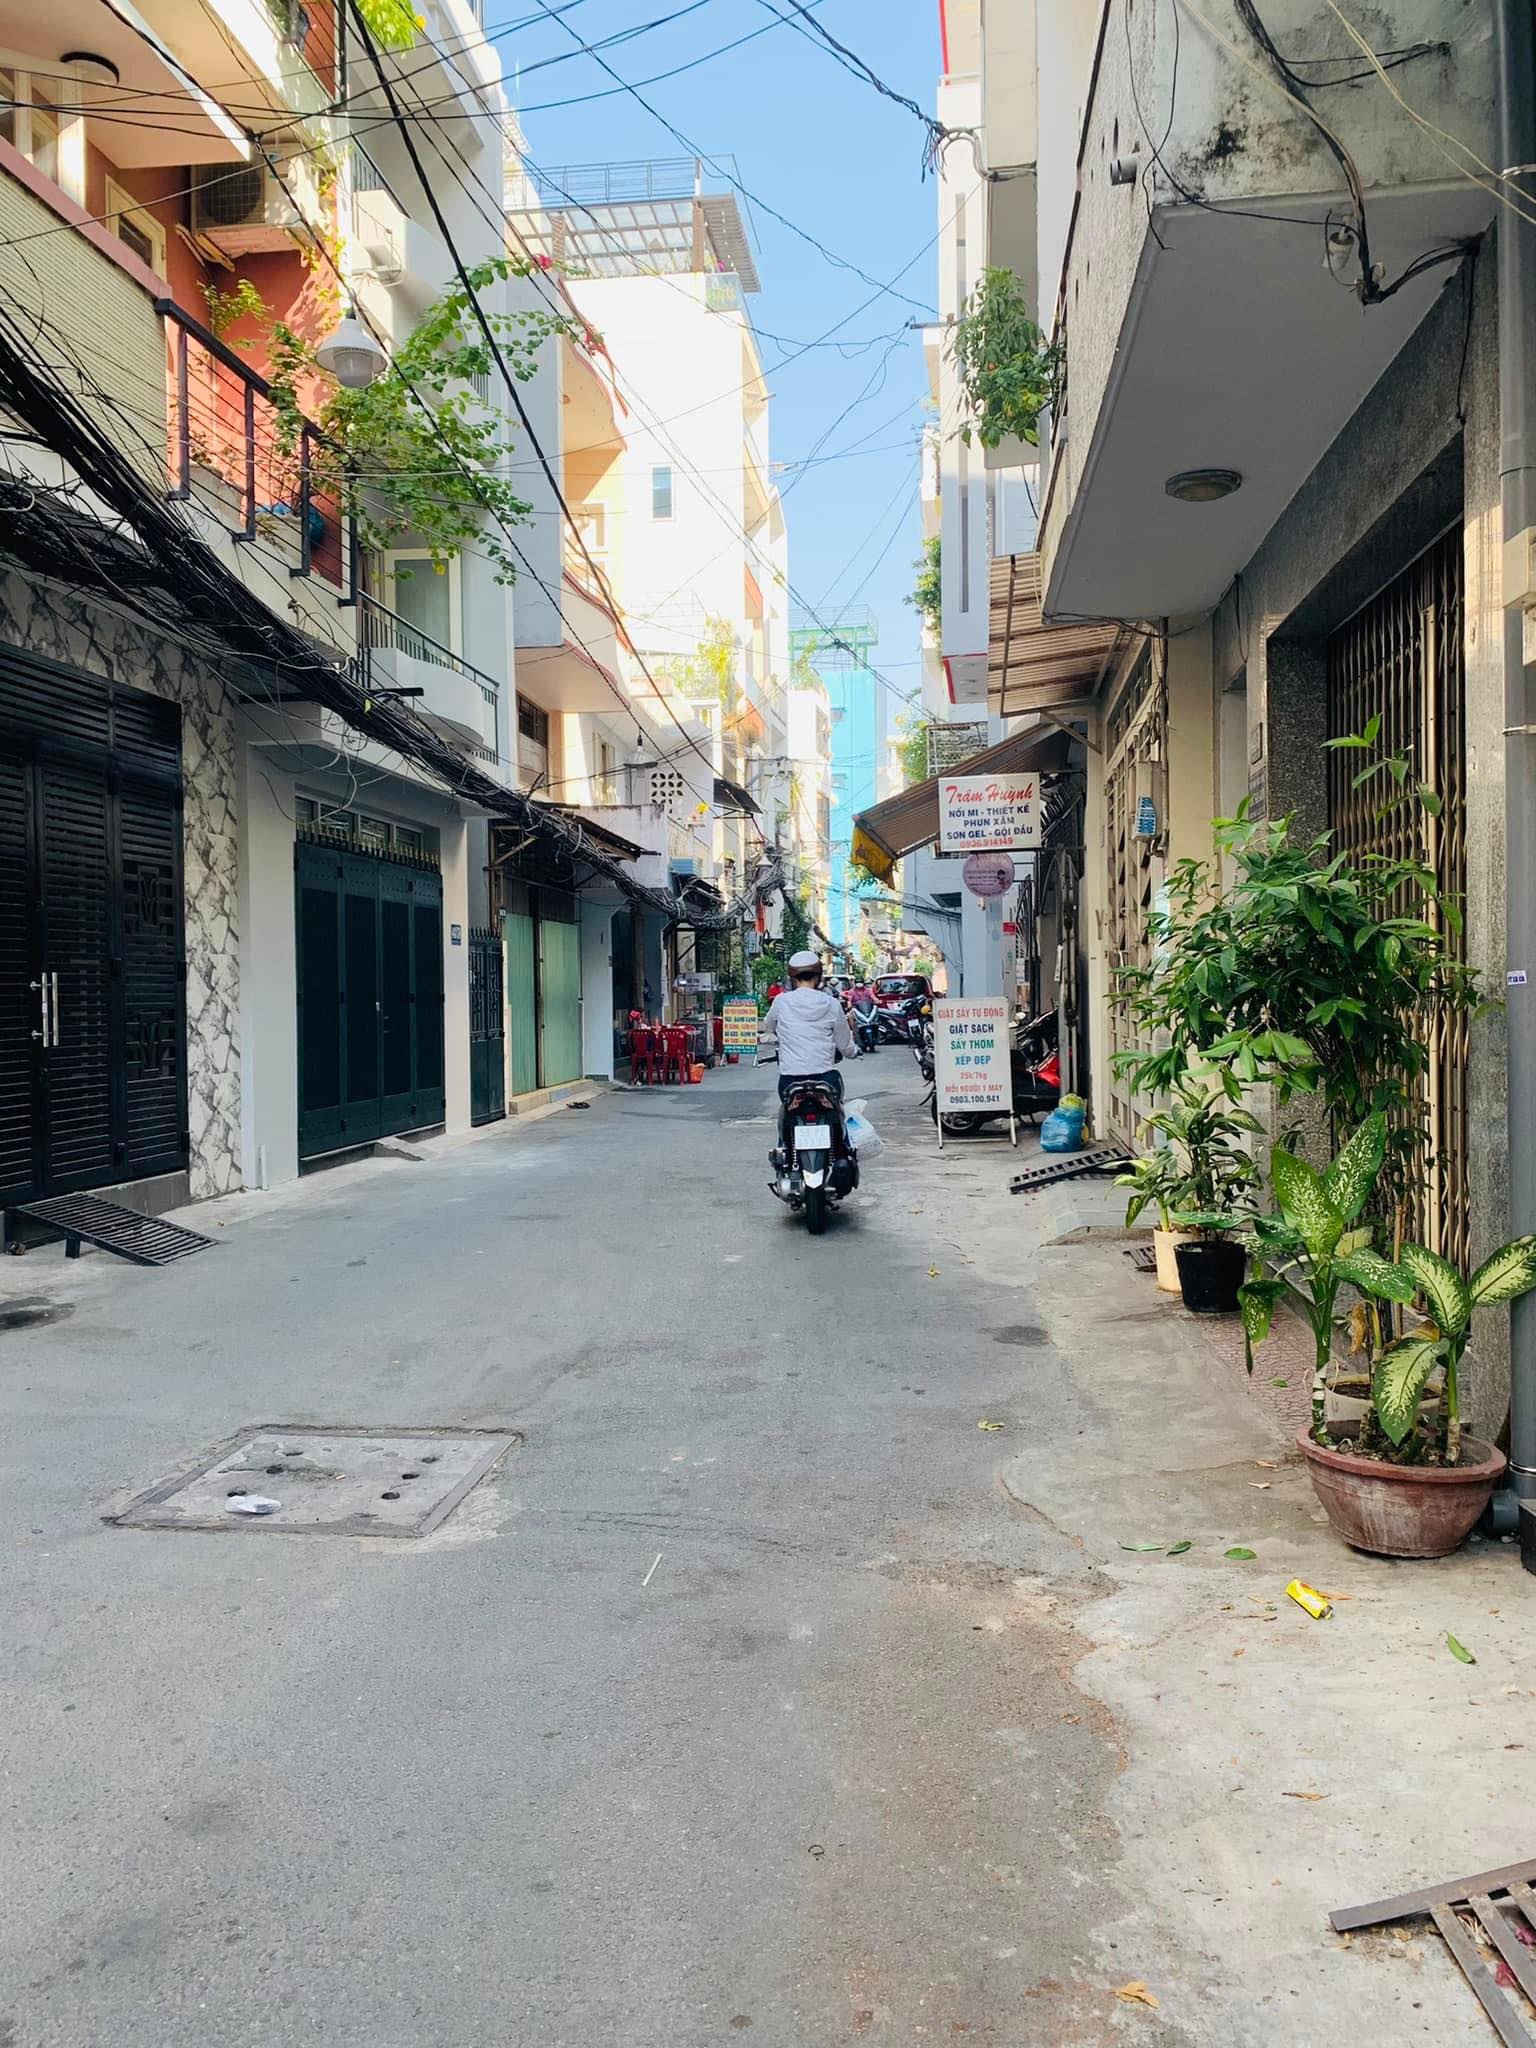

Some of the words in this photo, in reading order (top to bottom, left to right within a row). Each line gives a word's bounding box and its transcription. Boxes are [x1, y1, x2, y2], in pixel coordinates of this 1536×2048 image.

[985, 783, 1033, 805] Huỳnh
[948, 807, 965, 817] NỐI
[963, 818, 990, 827] PHUN
[968, 830, 986, 838] GEL
[949, 1024, 968, 1035] GIẶT
[971, 1024, 994, 1035] SẠCH
